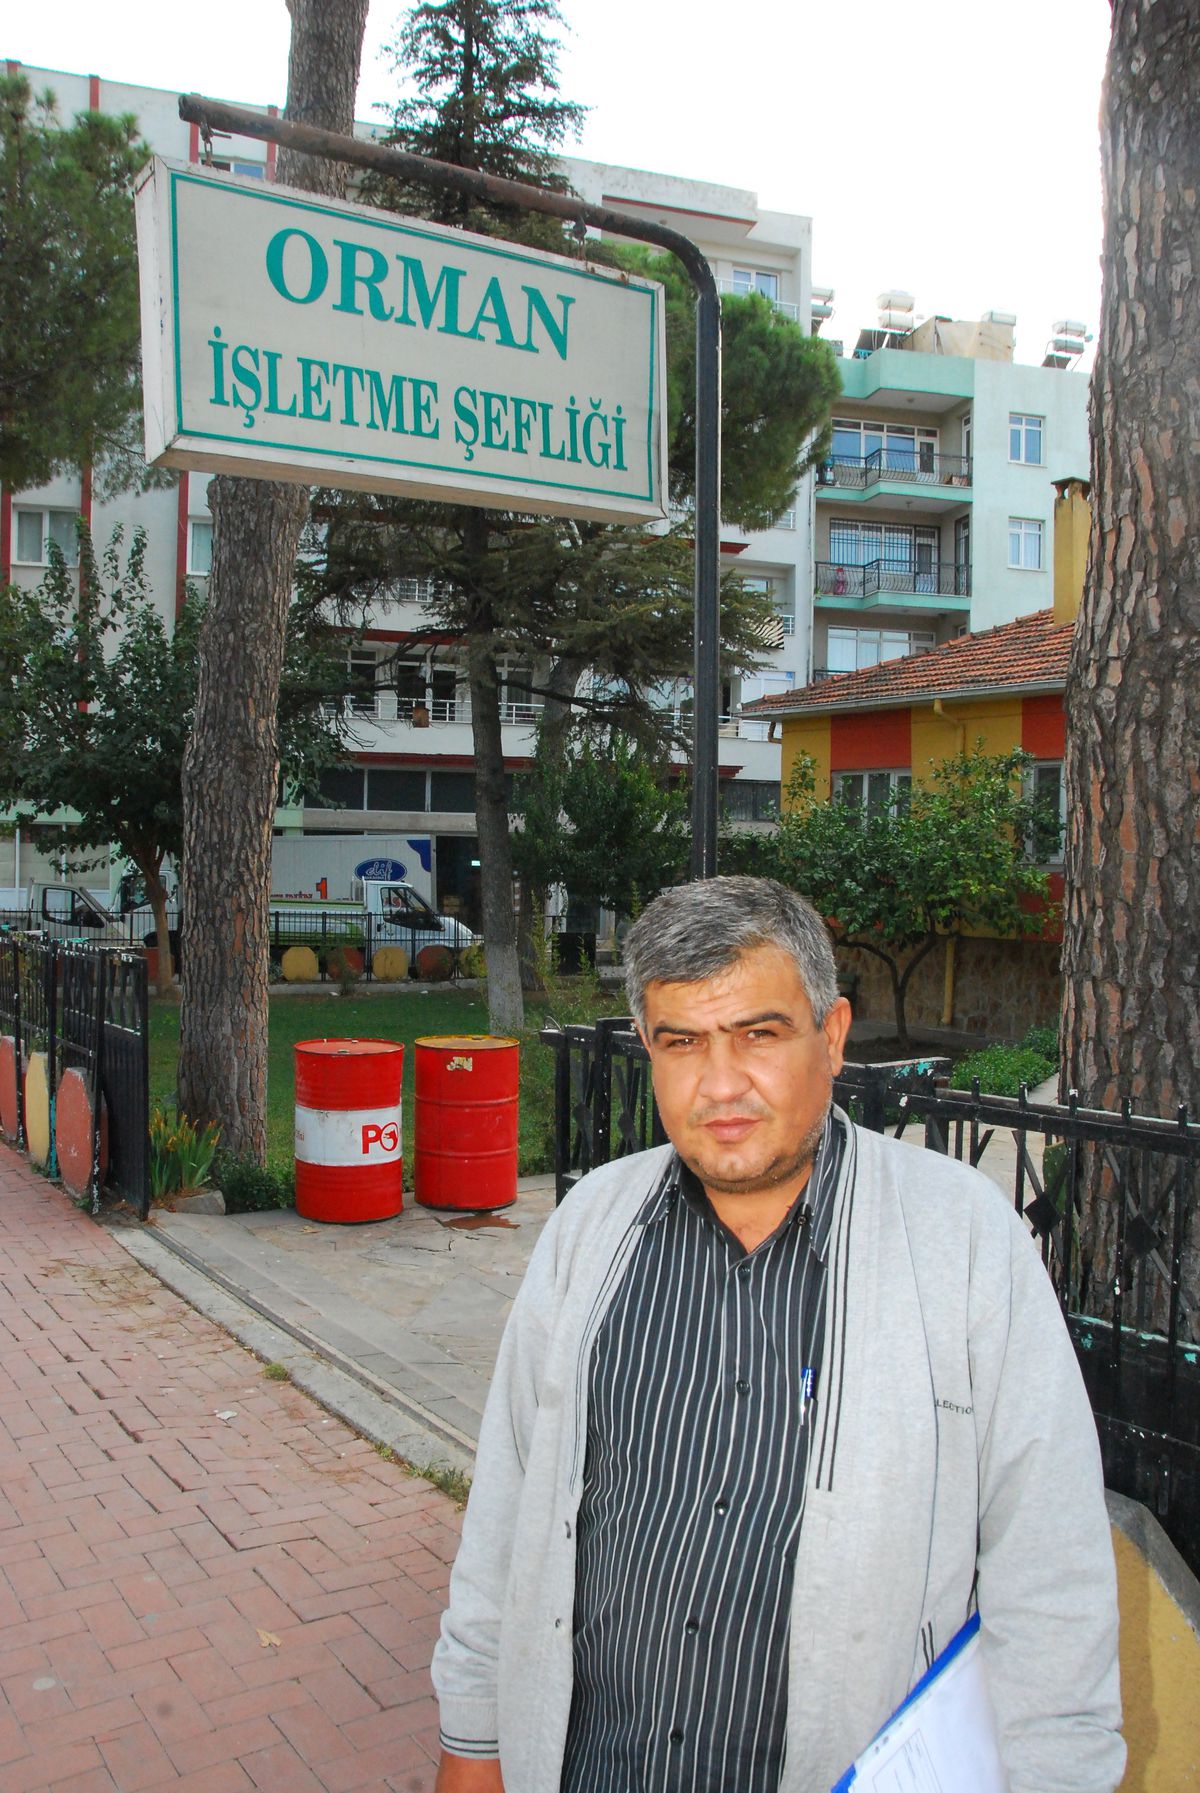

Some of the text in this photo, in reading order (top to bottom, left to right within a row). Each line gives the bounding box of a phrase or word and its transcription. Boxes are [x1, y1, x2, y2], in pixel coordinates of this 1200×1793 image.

[265, 226, 577, 361] ORMAN
[208, 325, 629, 472] İŞLETME ŞEFLİĞİ
[934, 1398, 975, 1415] LECTIO
